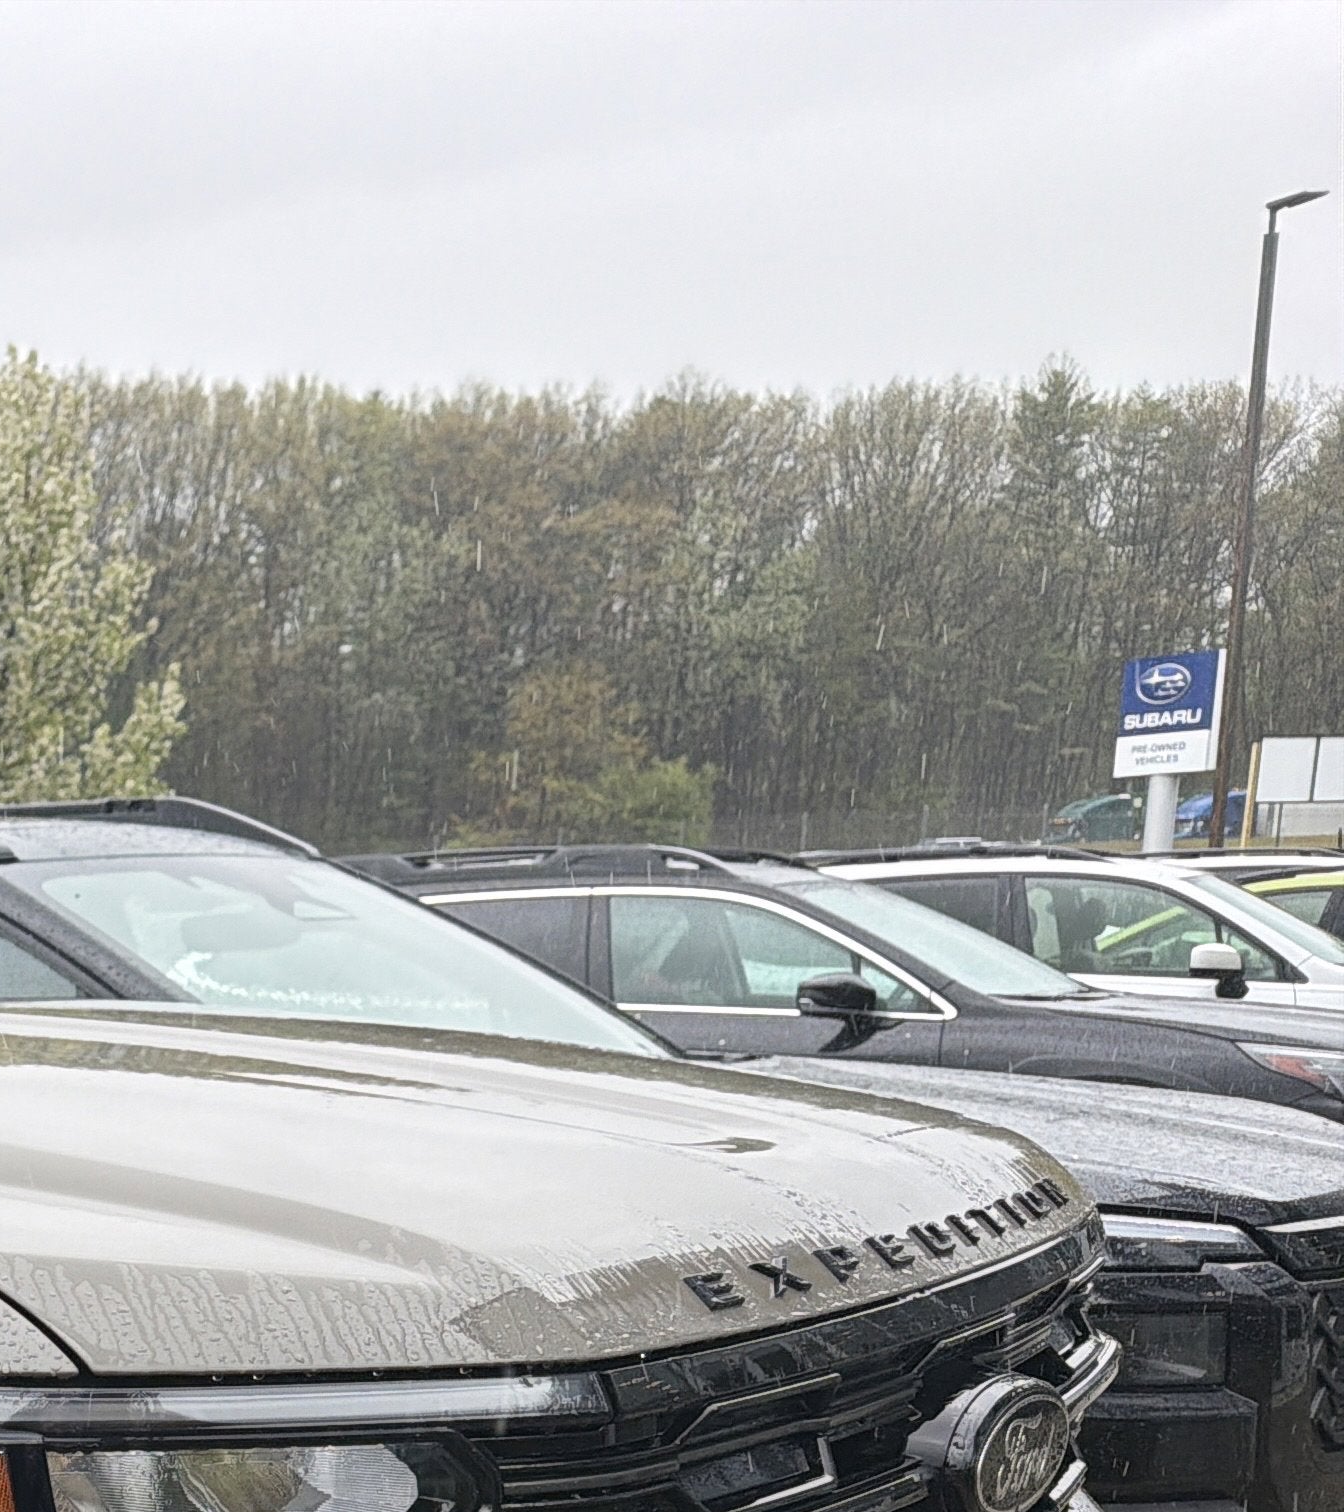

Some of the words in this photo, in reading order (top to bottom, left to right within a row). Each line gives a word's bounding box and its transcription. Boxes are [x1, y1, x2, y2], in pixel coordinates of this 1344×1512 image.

[1124, 708, 1203, 730] SUBARU
[1135, 754, 1180, 766] VEHICLES
[683, 1178, 1072, 1310] EXPEDITION
[996, 1411, 1056, 1501] Ford
